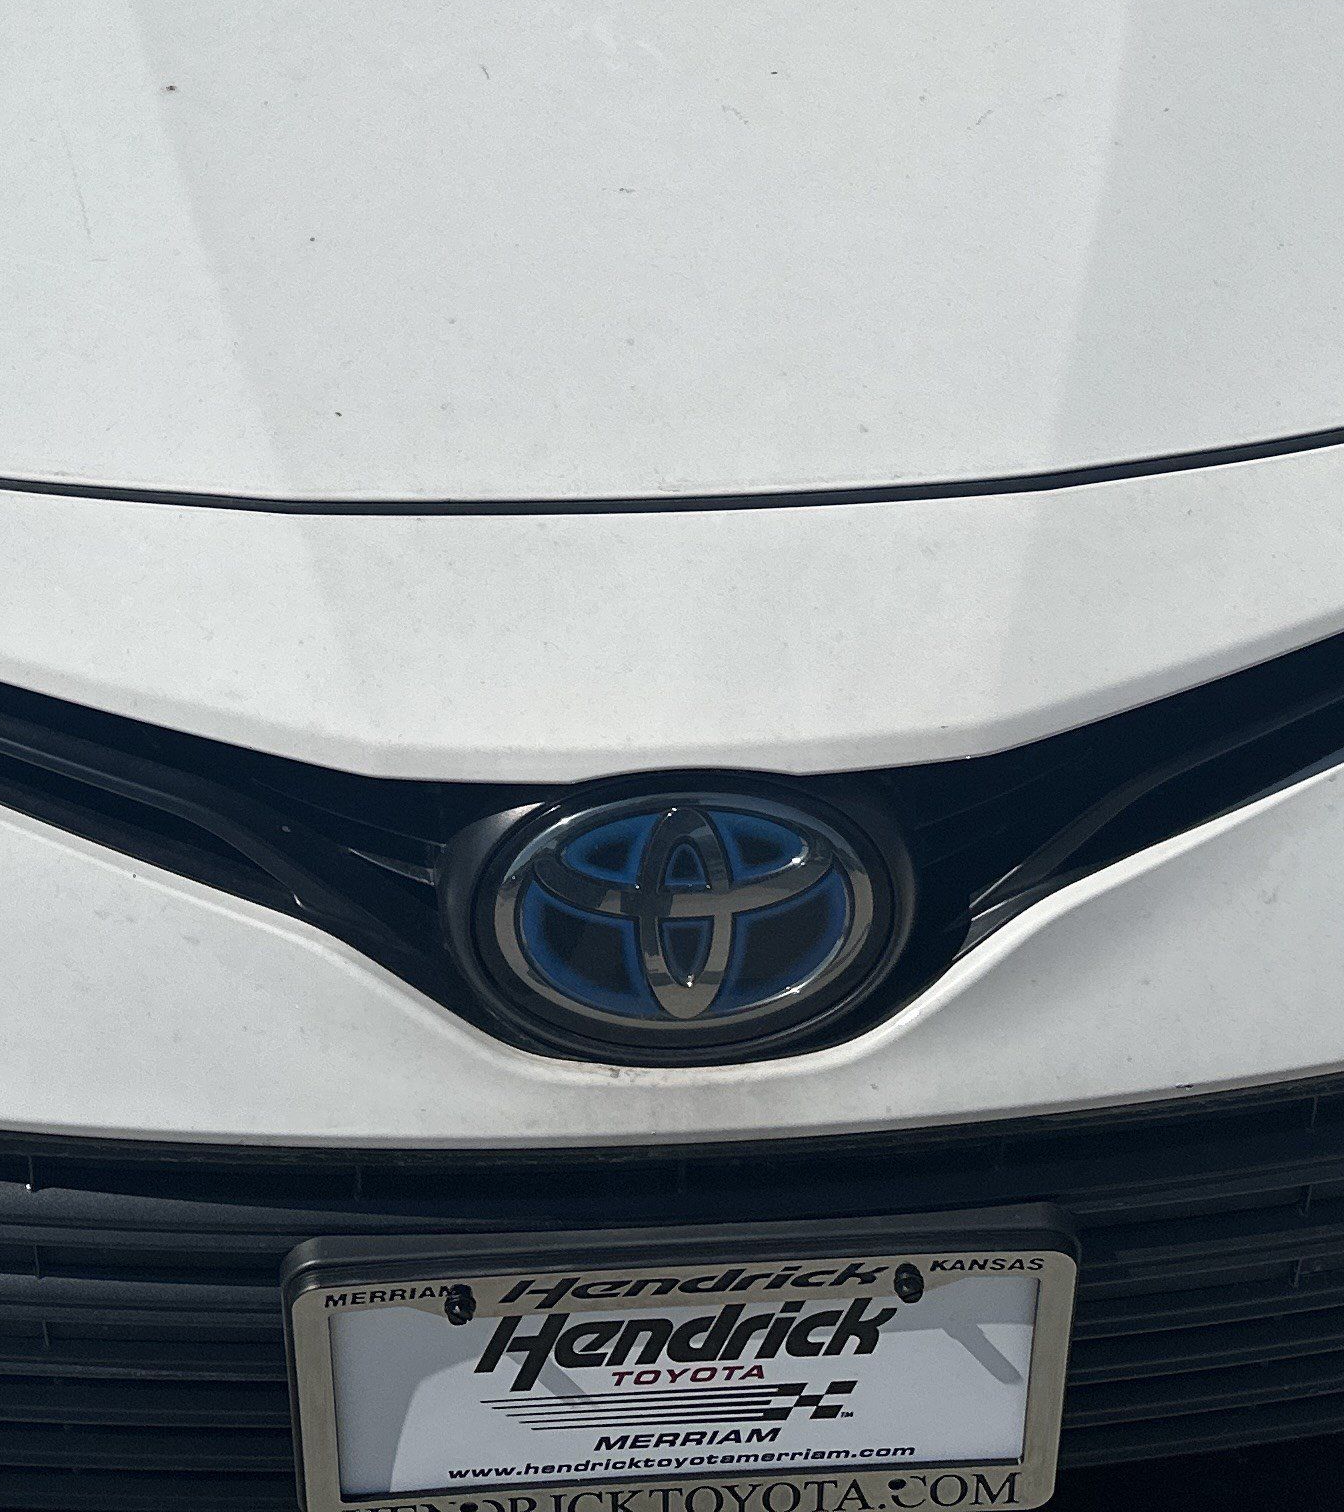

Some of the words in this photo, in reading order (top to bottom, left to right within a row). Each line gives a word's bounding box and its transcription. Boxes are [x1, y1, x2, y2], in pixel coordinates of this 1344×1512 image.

[929, 1257, 1045, 1272] KANSAS
[499, 1262, 889, 1309] Hendrick
[474, 1297, 897, 1392] Hendrick
[611, 1364, 765, 1387] TOYOTA
[593, 1427, 781, 1451] MERRIAM
[448, 1445, 916, 1480] www.hendricktoyotamerriam.com
[340, 1471, 1022, 1512] RICKTOYOTA.COM
